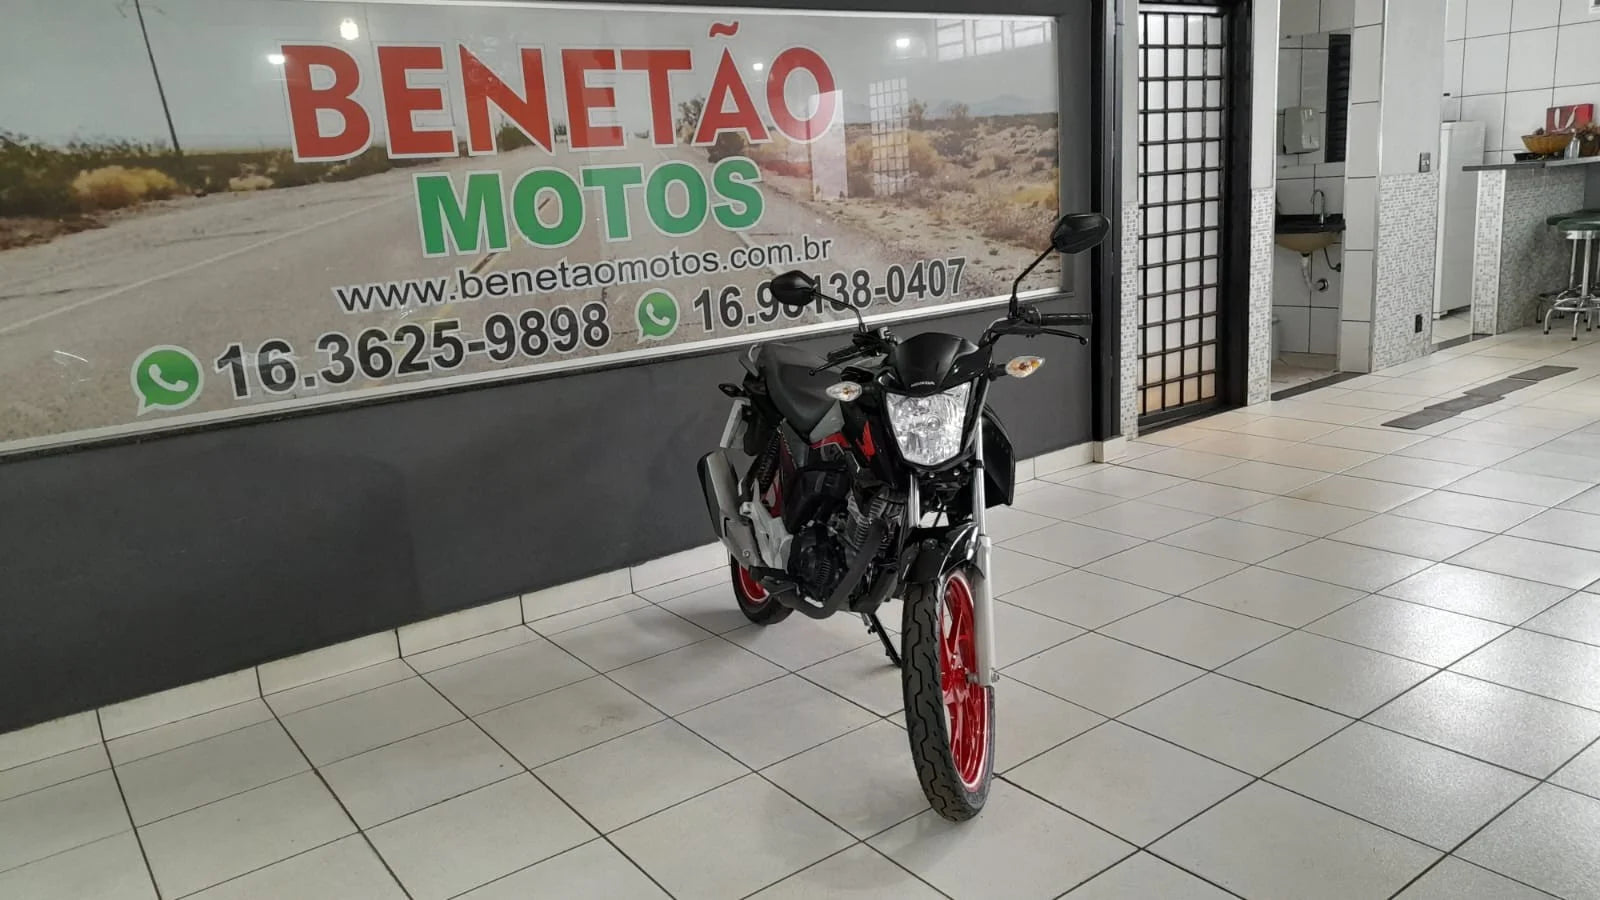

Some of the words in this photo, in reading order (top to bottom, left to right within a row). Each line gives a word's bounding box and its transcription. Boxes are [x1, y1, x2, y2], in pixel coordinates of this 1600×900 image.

[281, 21, 837, 159] BENETÃO
[414, 158, 765, 255] MOTOS
[337, 237, 832, 312] www.benetaomotos.com.br
[216, 302, 611, 397] 16.3625-9898
